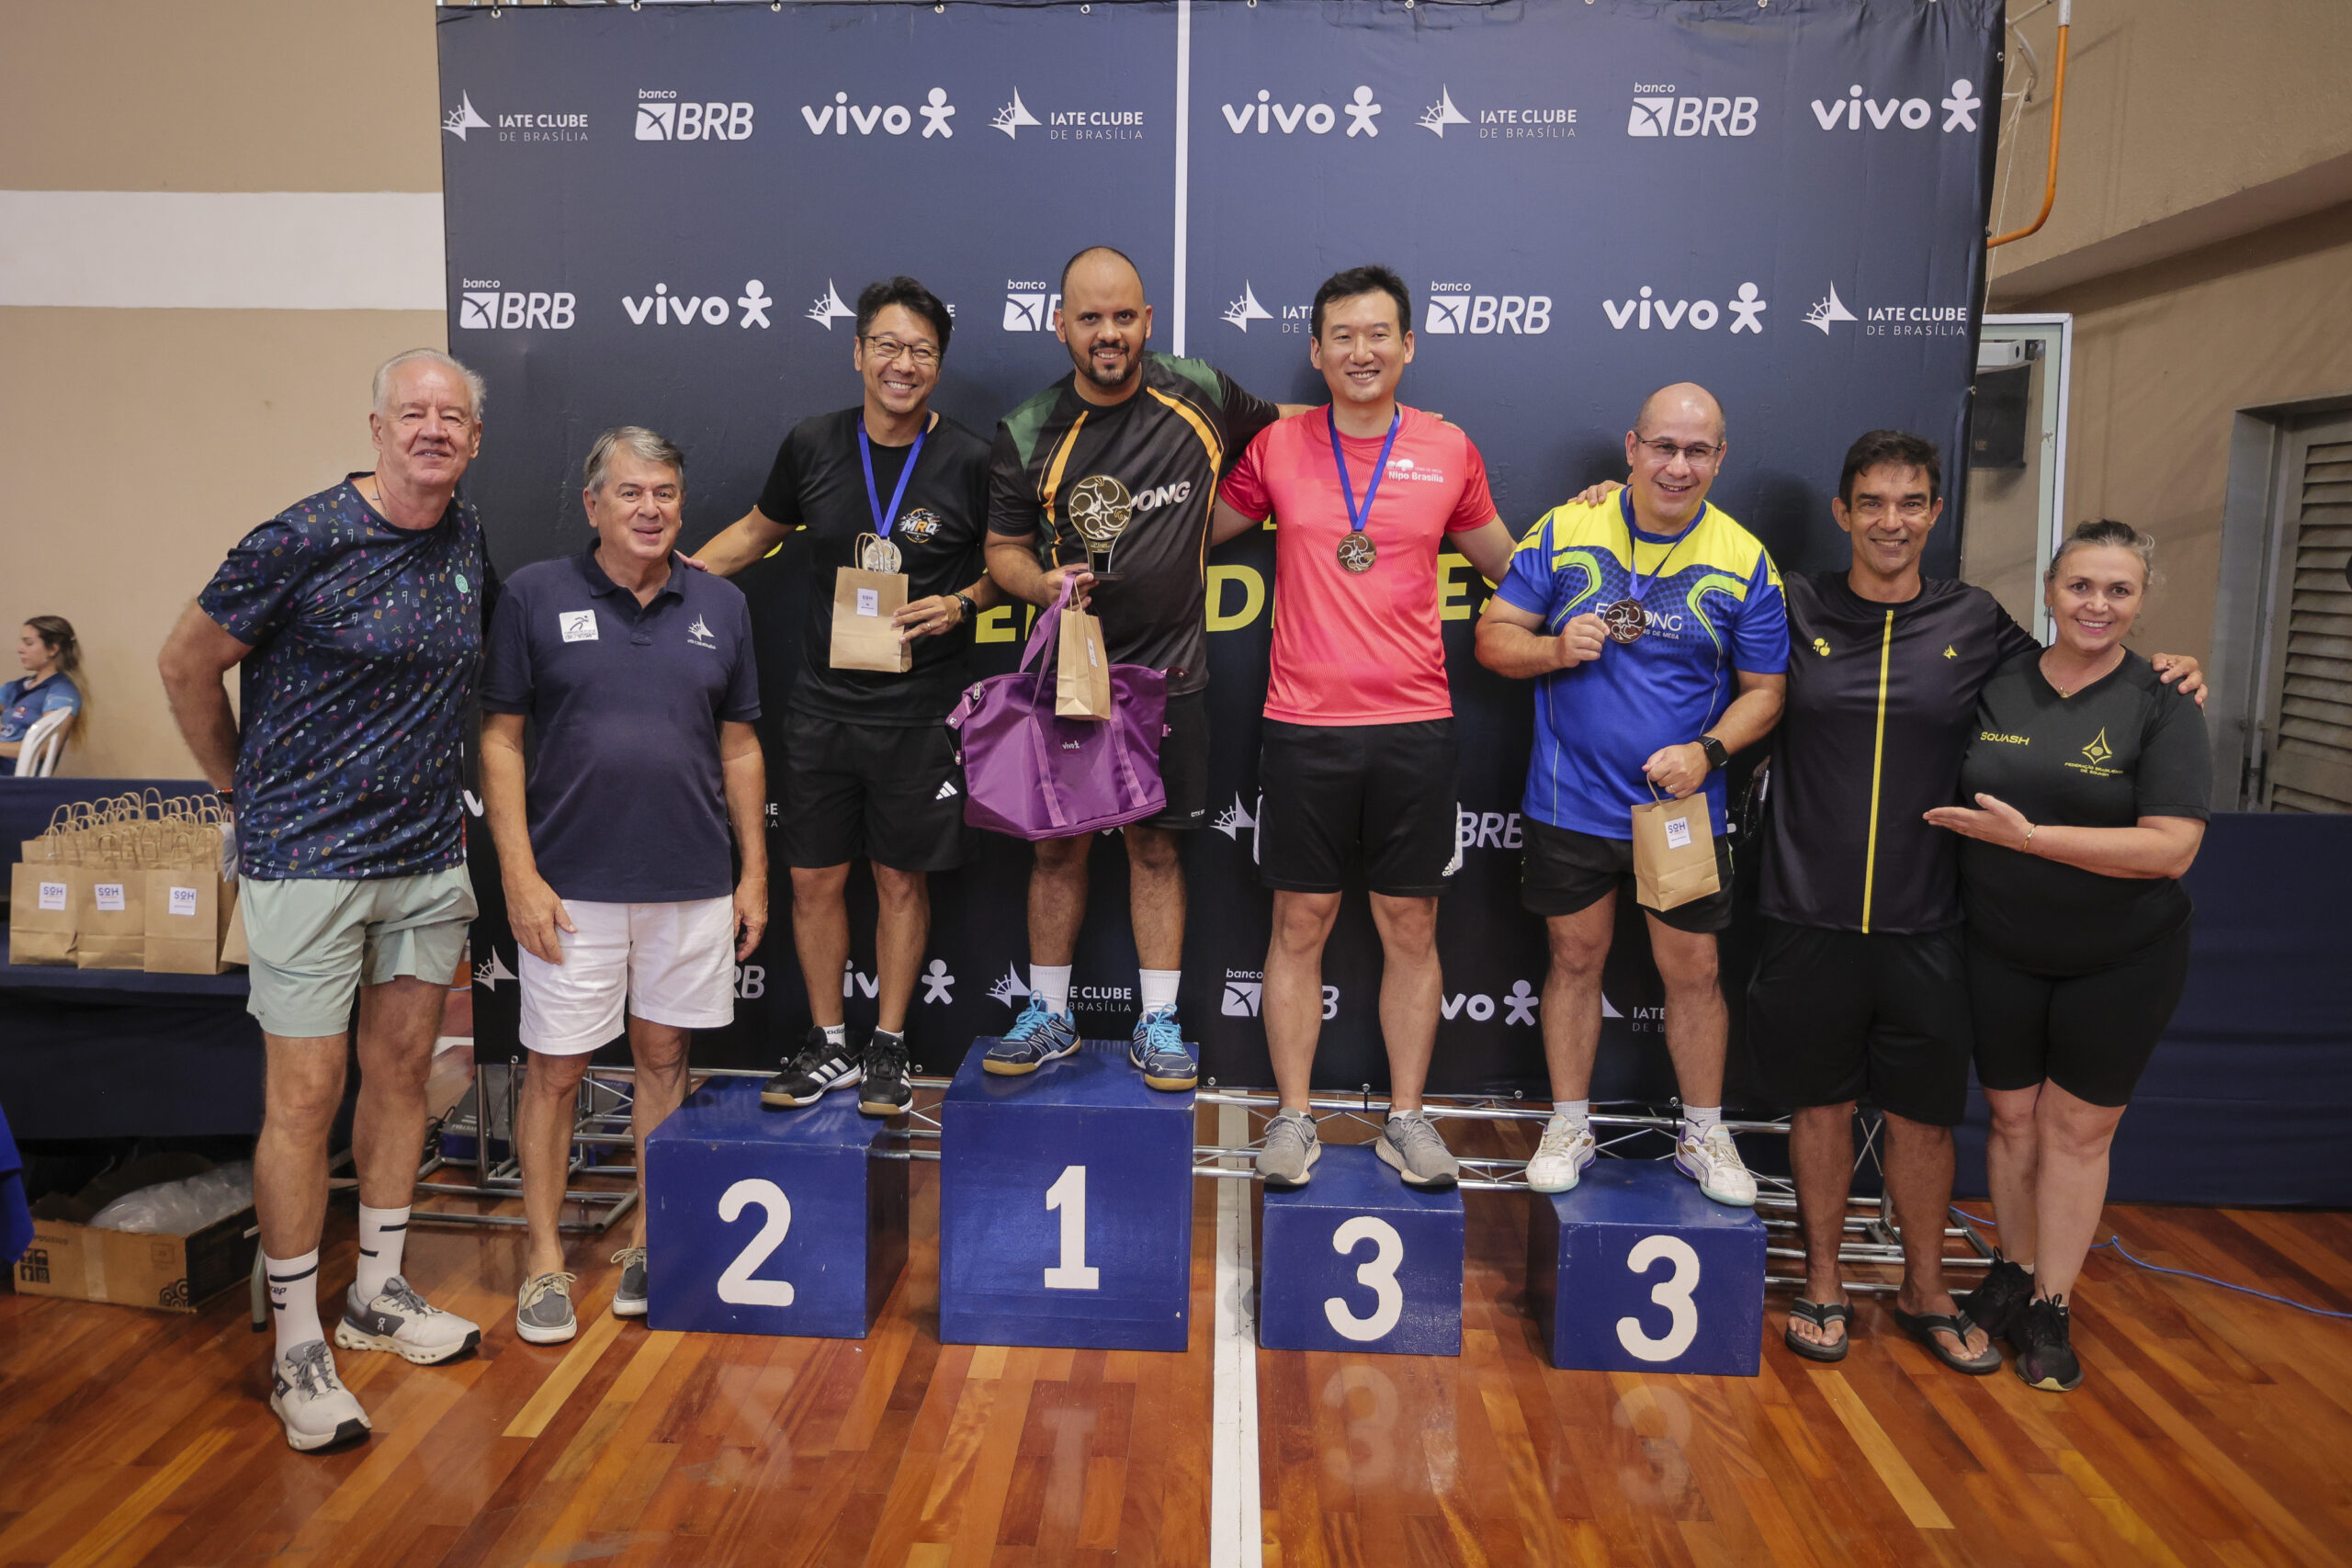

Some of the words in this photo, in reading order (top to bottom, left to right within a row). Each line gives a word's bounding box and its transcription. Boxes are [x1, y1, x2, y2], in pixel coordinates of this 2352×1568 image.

[639, 88, 677, 99] banco
[1634, 83, 1675, 93] banco
[801, 91, 911, 135] vivo
[1221, 89, 1336, 134] vivo
[1811, 84, 1931, 130] vivo
[499, 114, 534, 128] IATE
[537, 114, 589, 128] CLUBE
[675, 102, 754, 141] BRB
[1050, 111, 1086, 125] IATE
[1090, 111, 1144, 125] CLUBE
[1480, 110, 1517, 123] IATE
[1521, 110, 1577, 124] CLUBE
[1672, 96, 1759, 137] BRB
[499, 131, 516, 141] DE
[524, 129, 589, 141] BRASÍLIA
[1050, 130, 1068, 141] DE
[1076, 127, 1143, 140] BRASÍLIA
[1479, 128, 1498, 139] DE
[1506, 125, 1577, 138] BRASÍLIA
[462, 277, 501, 288] banco
[1007, 278, 1046, 290] banco
[1430, 280, 1472, 292] banco
[622, 282, 729, 325] vivo
[1602, 285, 1719, 331] vivo
[501, 292, 576, 330] BRB
[1467, 295, 1553, 334] BRB
[1868, 307, 1905, 321] IATE
[1909, 307, 1967, 321] CLUBE
[1282, 322, 1300, 333] DE
[1866, 325, 1885, 336] DE
[1894, 322, 1965, 336] BRASÍLIA
[902, 519, 937, 535] MRQ
[1662, 632, 1679, 640] MESA
[1061, 741, 1075, 750] vivo
[1980, 731, 2030, 746] SQUASH
[843, 960, 879, 998] iv
[1226, 967, 1264, 979] banco
[1081, 986, 1132, 1000] CLUBE
[1069, 1001, 1132, 1012] BRASÍLIA
[1442, 993, 1495, 1021] vo
[1632, 1022, 1649, 1032] DE
[1044, 1165, 1100, 1290] 1
[717, 1178, 795, 1307] 2
[1324, 1215, 1405, 1341] 3
[1615, 1235, 1700, 1362] 3
